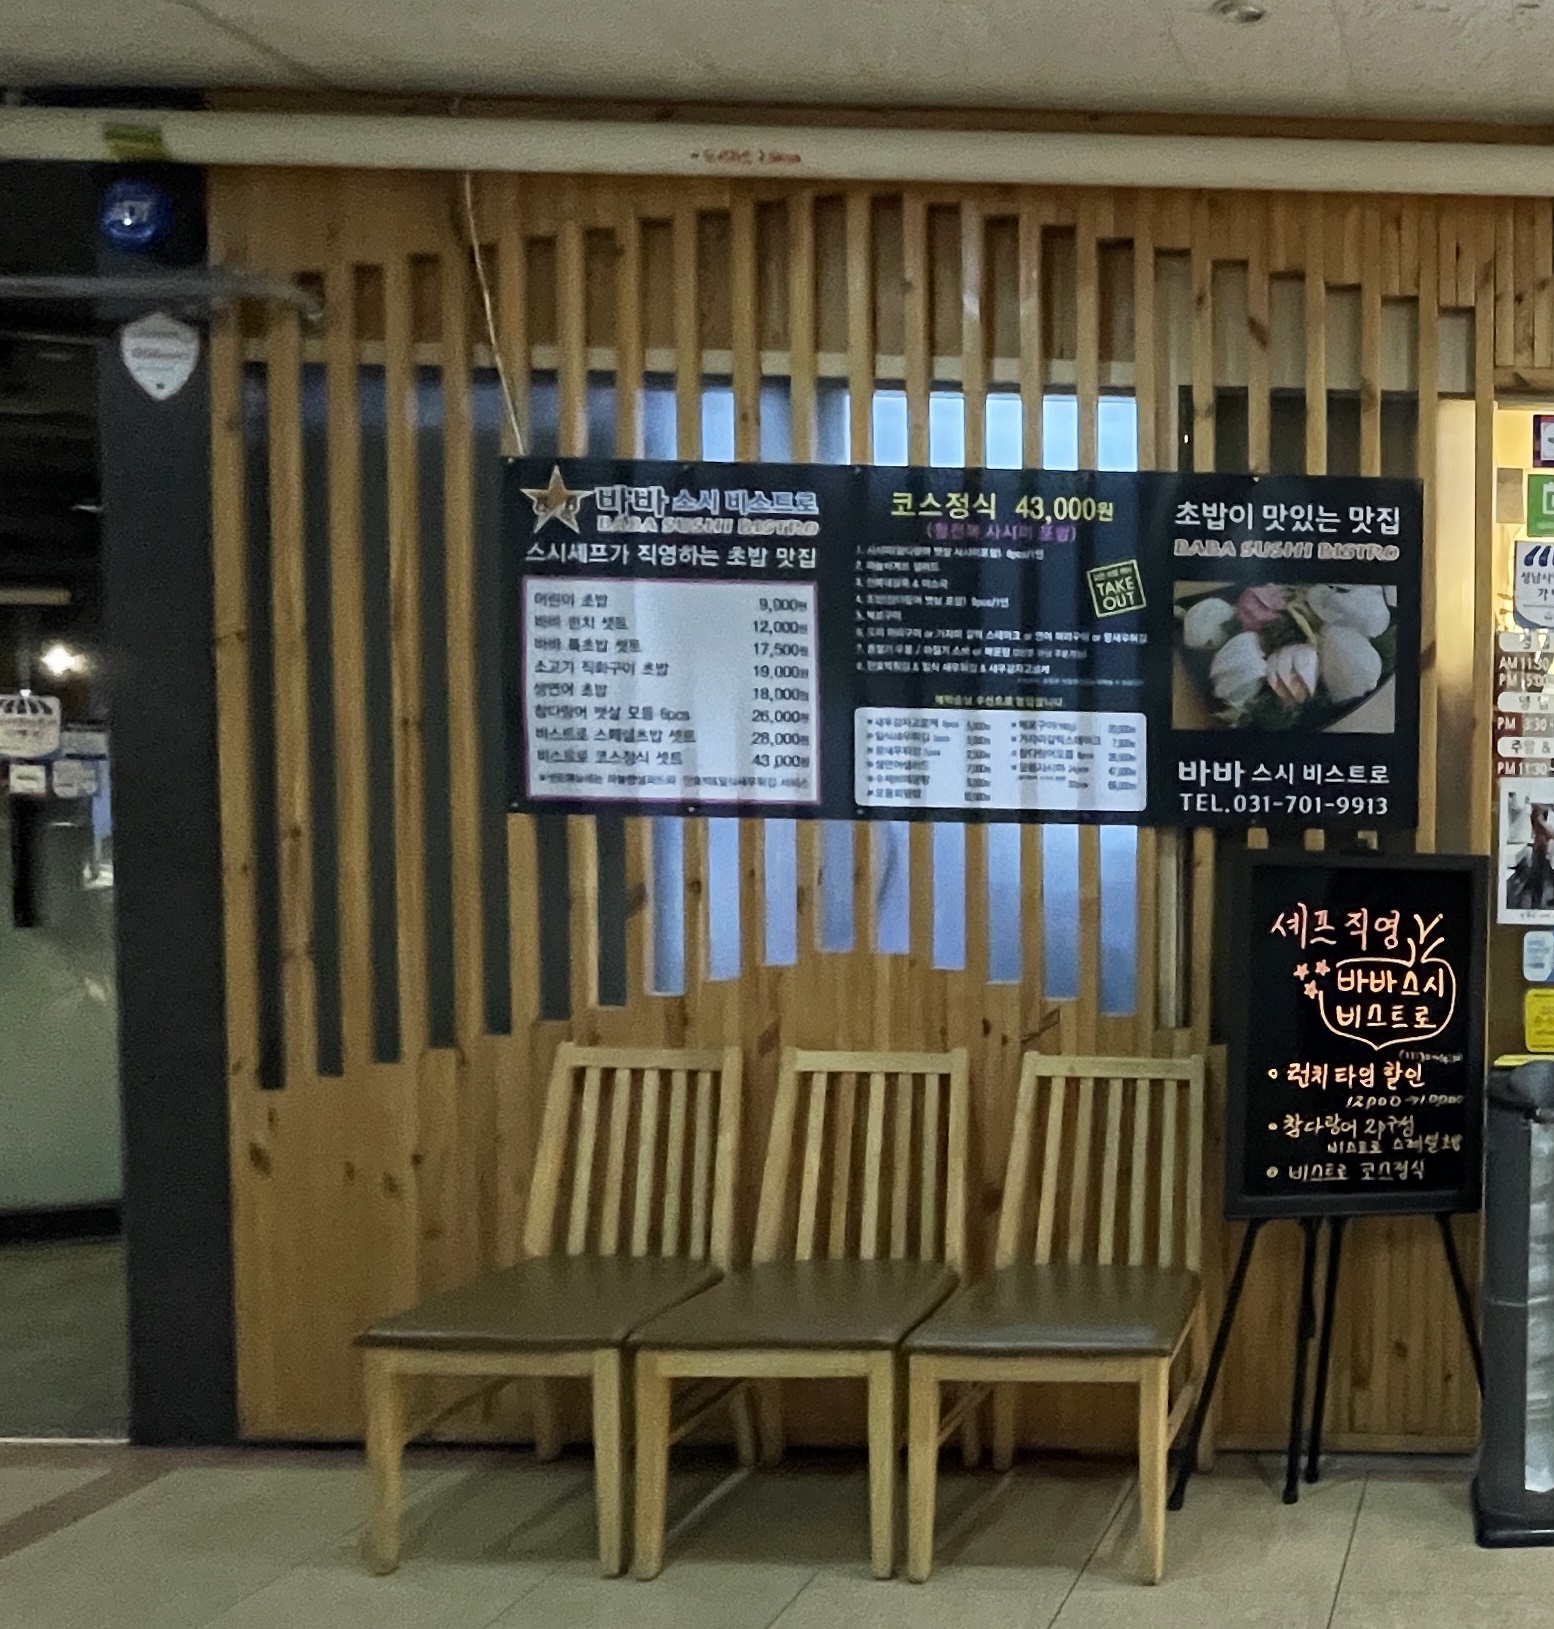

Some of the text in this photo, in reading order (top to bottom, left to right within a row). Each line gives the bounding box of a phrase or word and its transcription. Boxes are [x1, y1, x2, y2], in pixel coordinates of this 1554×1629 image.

[595, 485, 819, 517] 바바 스시 비스트로
[891, 492, 1114, 523] 코스정식 43,000원
[597, 515, 820, 536] BABA SUSHI BISTRO
[1174, 501, 1400, 535] 초밥이 맛있는 맛집
[637, 544, 719, 568] 직영하는
[727, 546, 768, 568] 초밥
[776, 548, 817, 569] 맛집
[1173, 539, 1400, 561] BABA SUSHI BISTRO
[1096, 576, 1135, 597] TAKE
[1102, 591, 1135, 610] OUT
[1497, 716, 1516, 730] PM
[1178, 759, 1390, 787] 바바 스시 비스트로
[1179, 791, 1389, 816] TEL.031-701-9913
[1345, 906, 1400, 951] 직영
[1336, 1003, 1437, 1029] 비스트로
[1286, 1060, 1426, 1091] 런치 타임 할인
[1282, 1112, 1358, 1140] 참다랑어
[1288, 1159, 1427, 1183] 비스트로 코스정식
